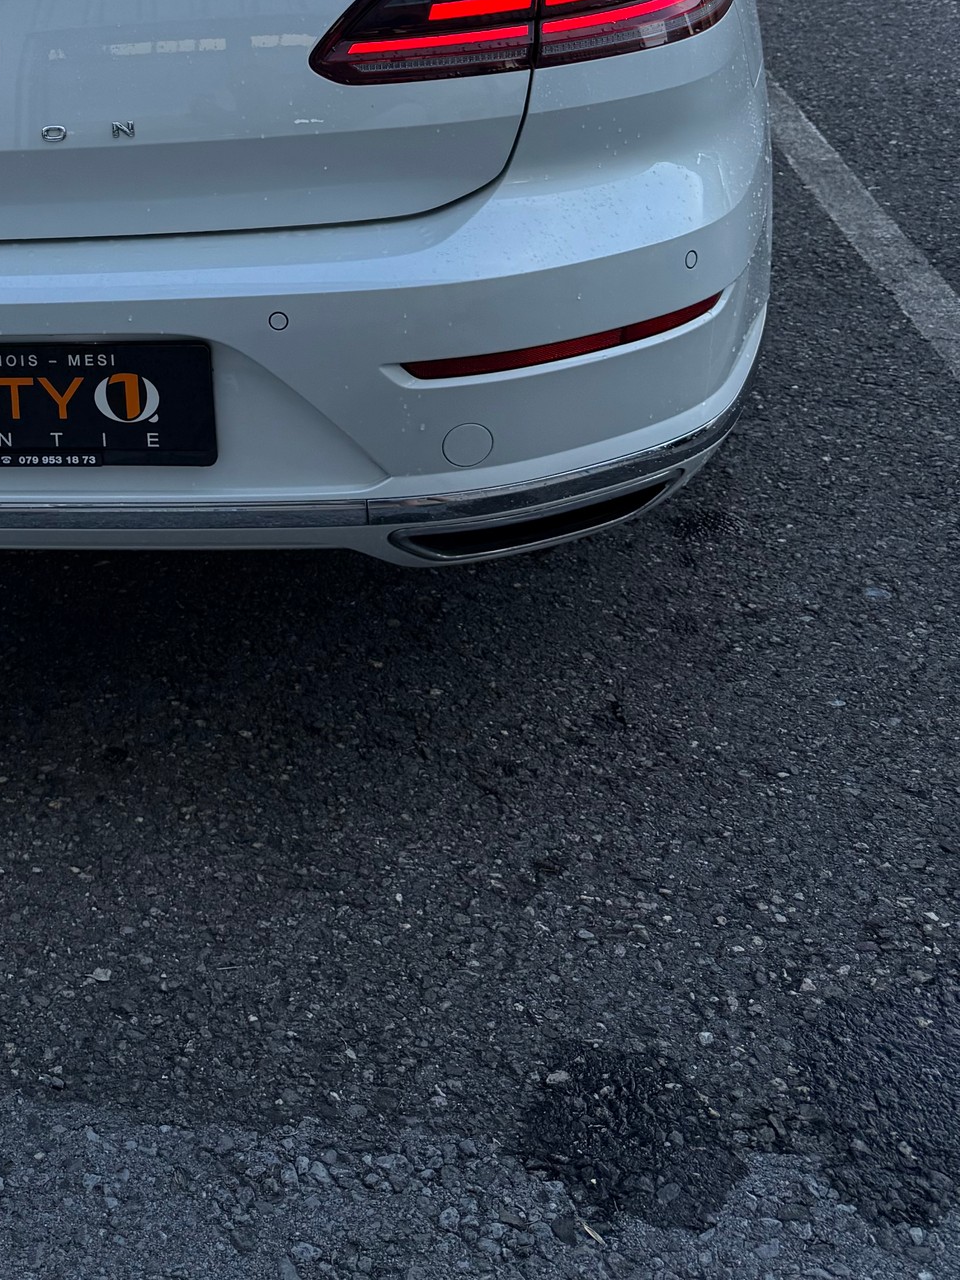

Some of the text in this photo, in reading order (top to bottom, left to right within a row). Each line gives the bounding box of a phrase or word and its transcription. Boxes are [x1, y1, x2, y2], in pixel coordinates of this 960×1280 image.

[68, 354, 115, 367] MESI
[18, 456, 39, 464] 079
[41, 456, 62, 464] 953
[65, 456, 79, 464] 18
[82, 456, 96, 464] 73
